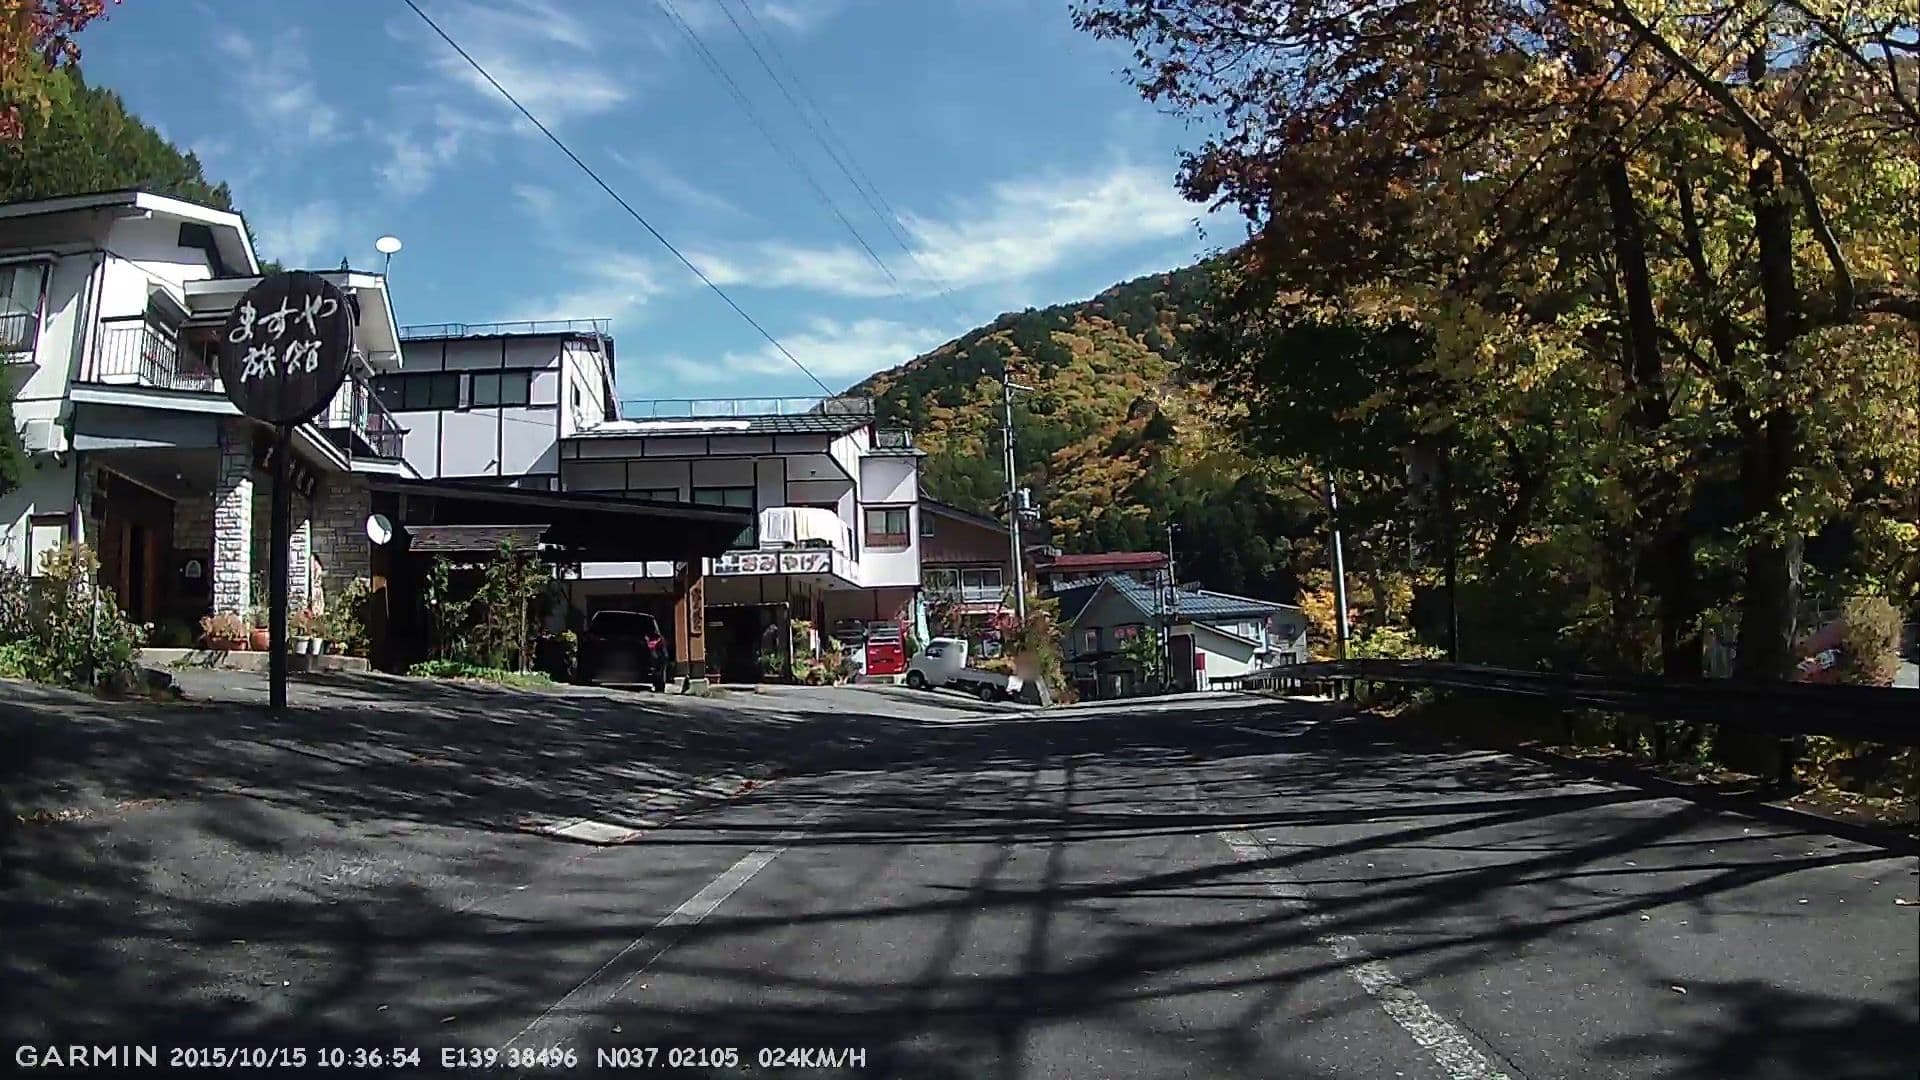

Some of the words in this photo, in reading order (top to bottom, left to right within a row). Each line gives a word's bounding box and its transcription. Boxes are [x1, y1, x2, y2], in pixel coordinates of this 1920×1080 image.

[230, 294, 338, 342] ますや
[240, 340, 323, 383] 旅館
